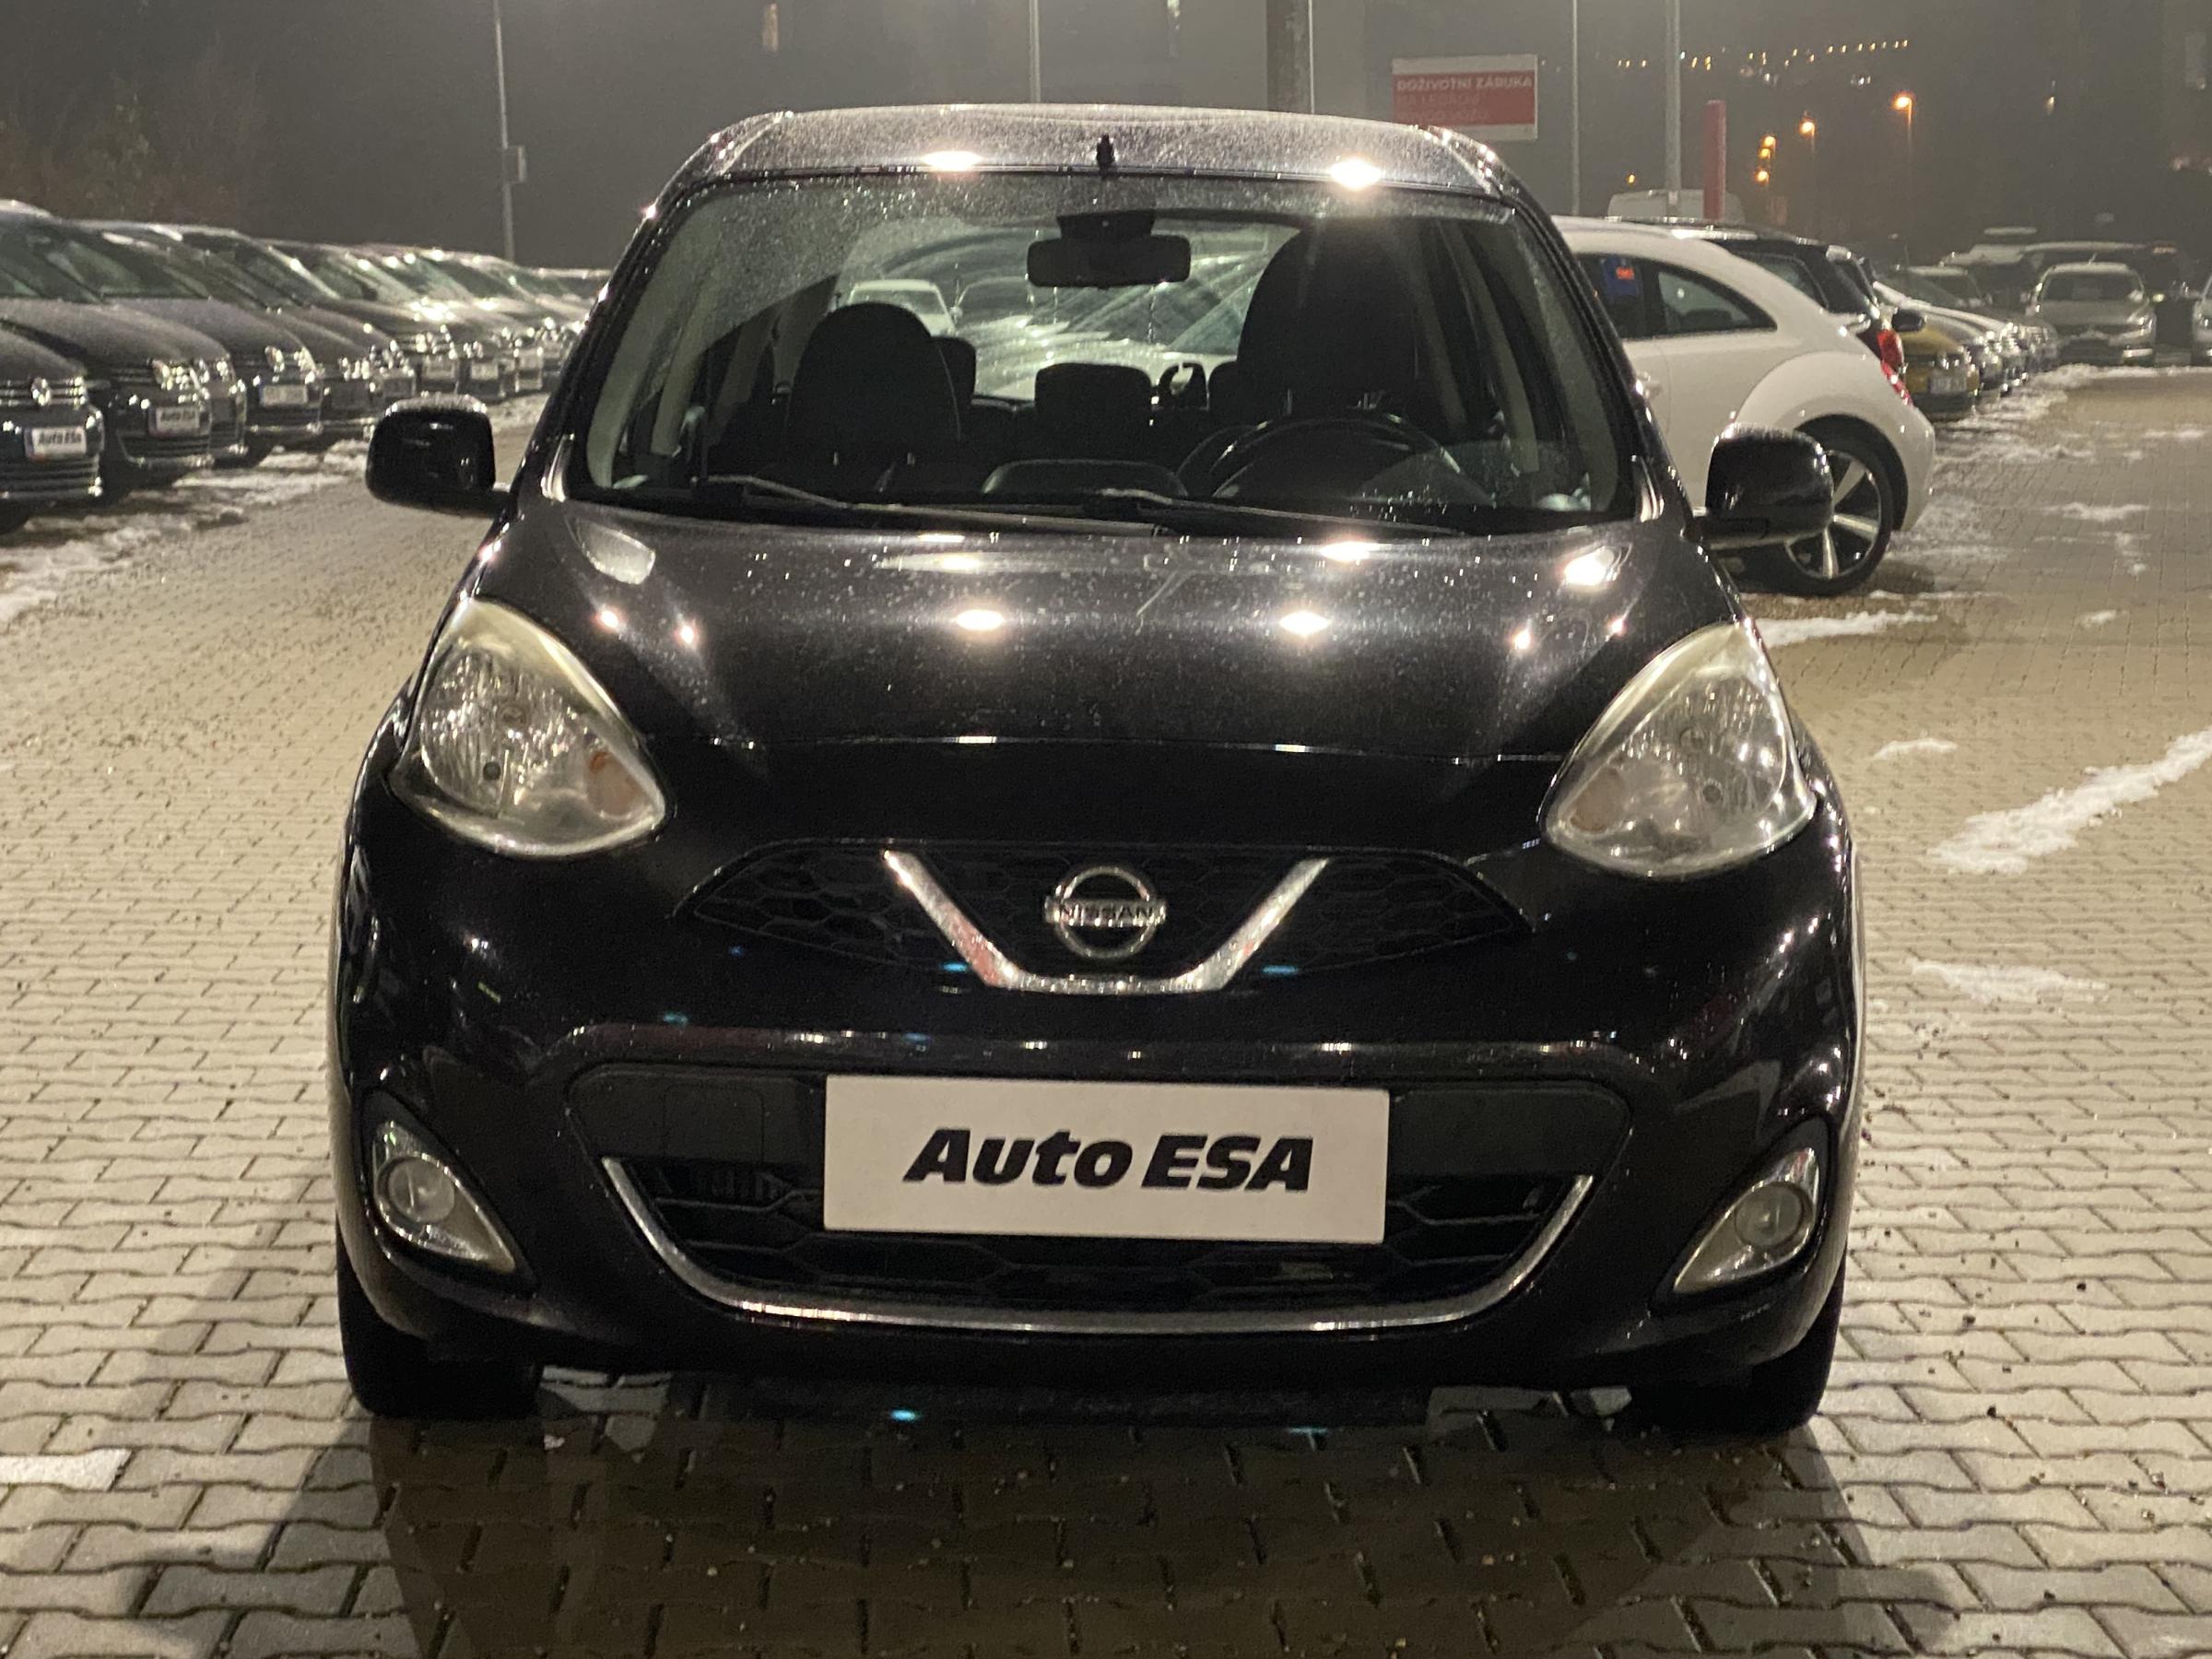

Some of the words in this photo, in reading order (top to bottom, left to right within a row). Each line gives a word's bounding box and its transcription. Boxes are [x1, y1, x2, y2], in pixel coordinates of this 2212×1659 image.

[1056, 902, 1156, 924] NISSAN
[903, 1128, 1133, 1187] Auto
[1141, 1135, 1313, 1192] ESA
